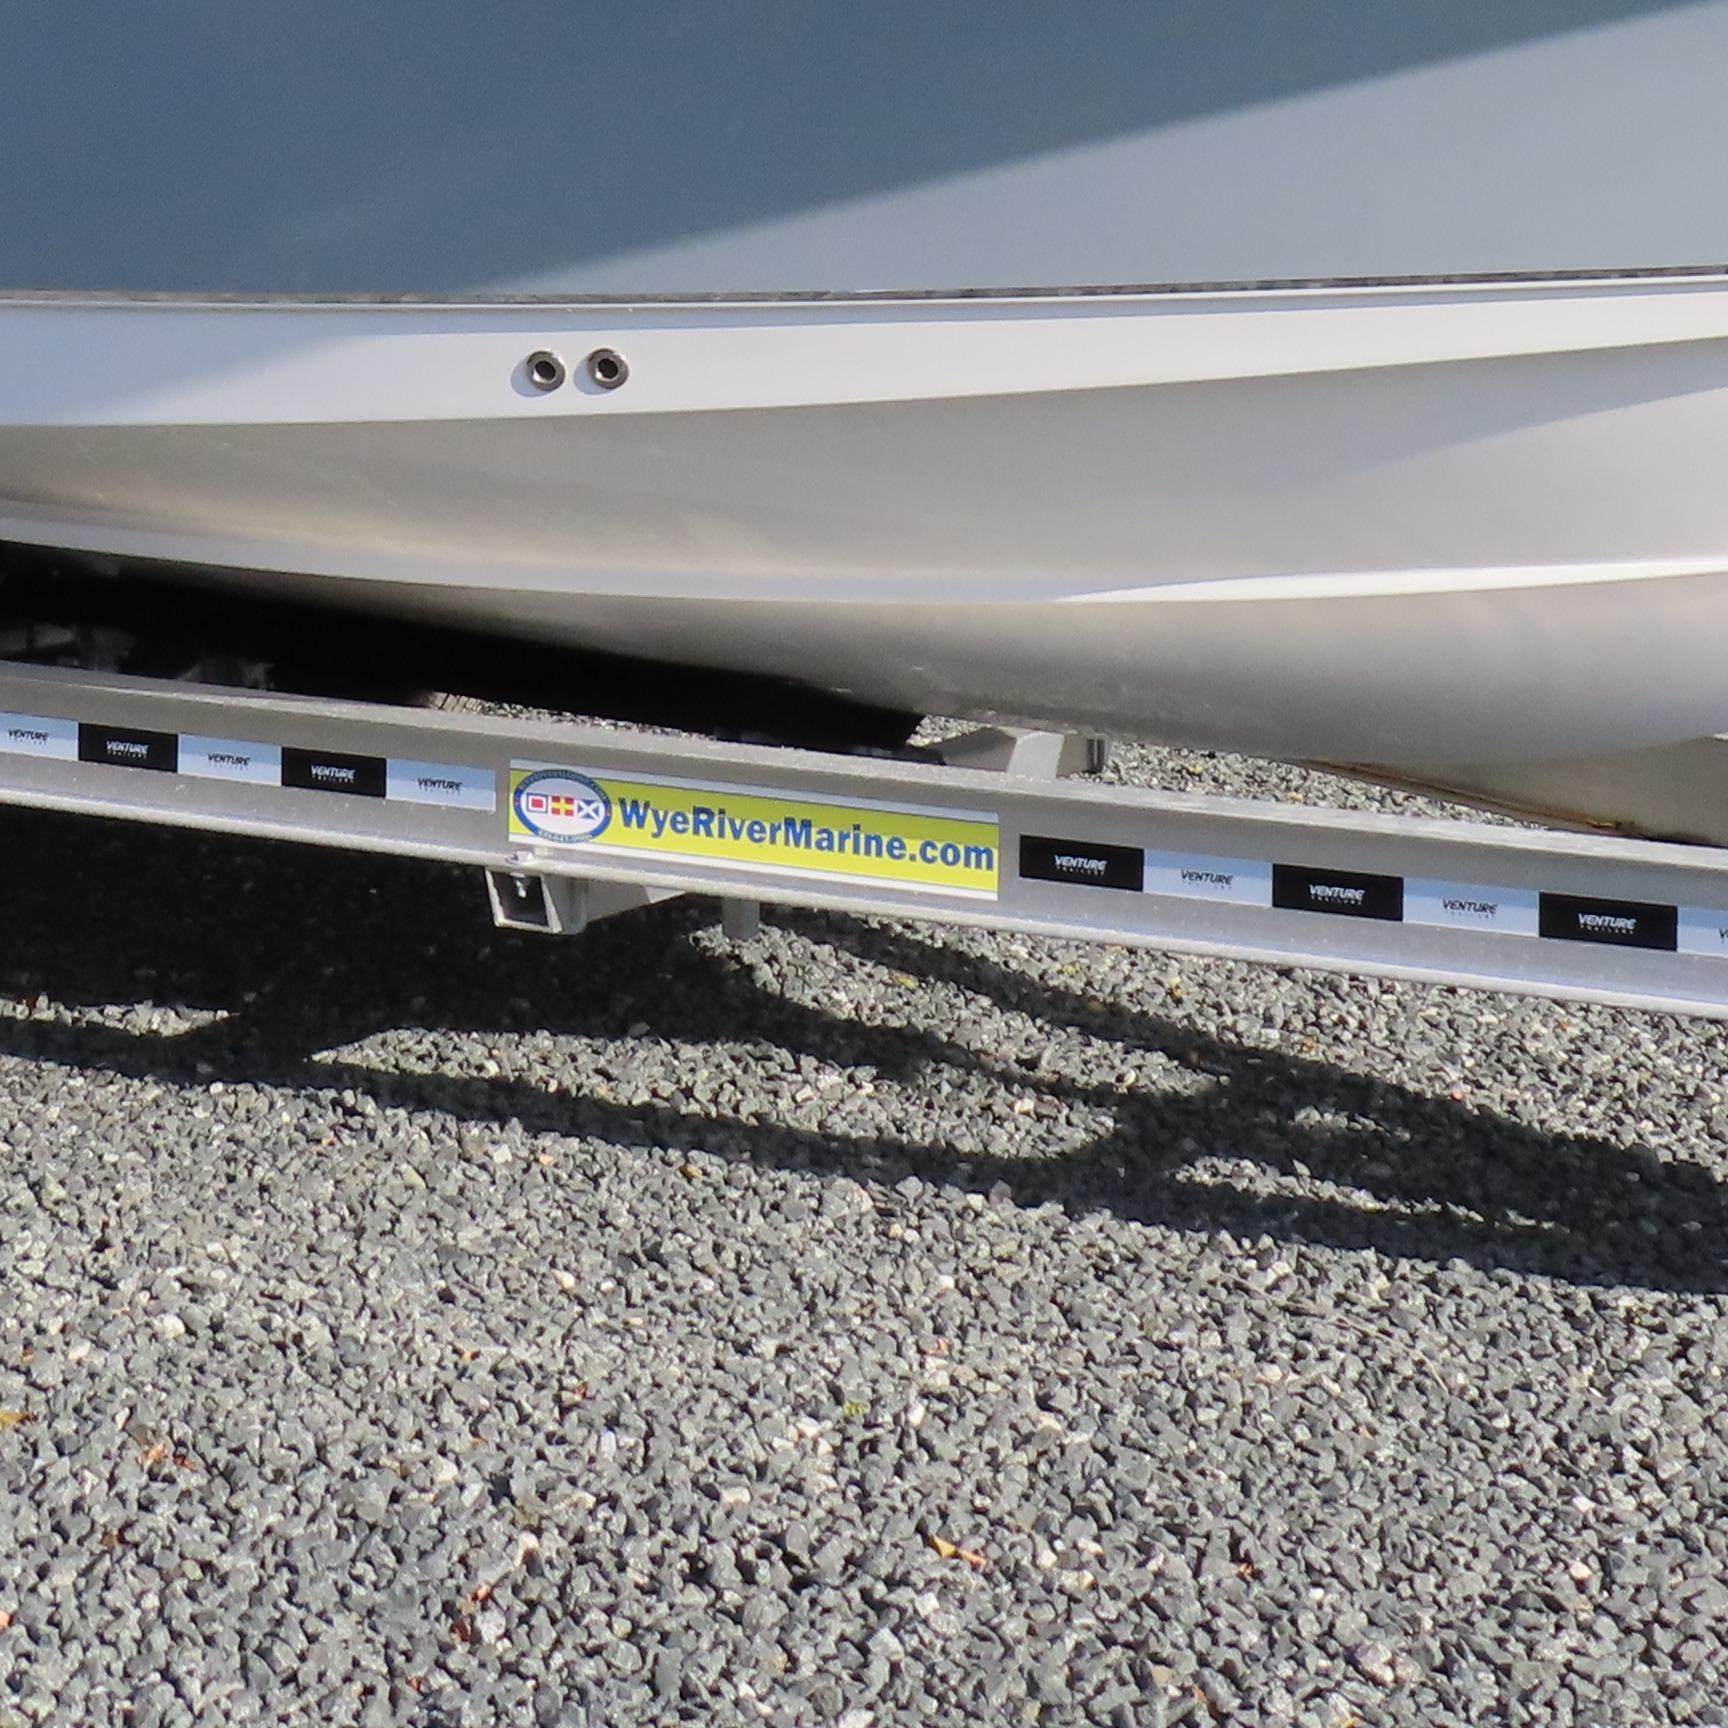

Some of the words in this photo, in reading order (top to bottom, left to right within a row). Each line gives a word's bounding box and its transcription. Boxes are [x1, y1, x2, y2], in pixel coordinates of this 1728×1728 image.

[8, 729, 50, 742] VENTURE
[106, 740, 149, 755] VENTURE
[208, 753, 250, 766] VENTURE
[311, 765, 356, 780] VENTURE
[417, 777, 463, 792] VENTURE
[618, 797, 994, 871] WyeRiverMarine.com
[1054, 854, 1108, 872] VENTURE
[1180, 869, 1234, 885] VENTURE
[1308, 883, 1366, 902] VENTURE
[1442, 899, 1499, 915] VENTURE
[1577, 913, 1637, 931] VENTURE
